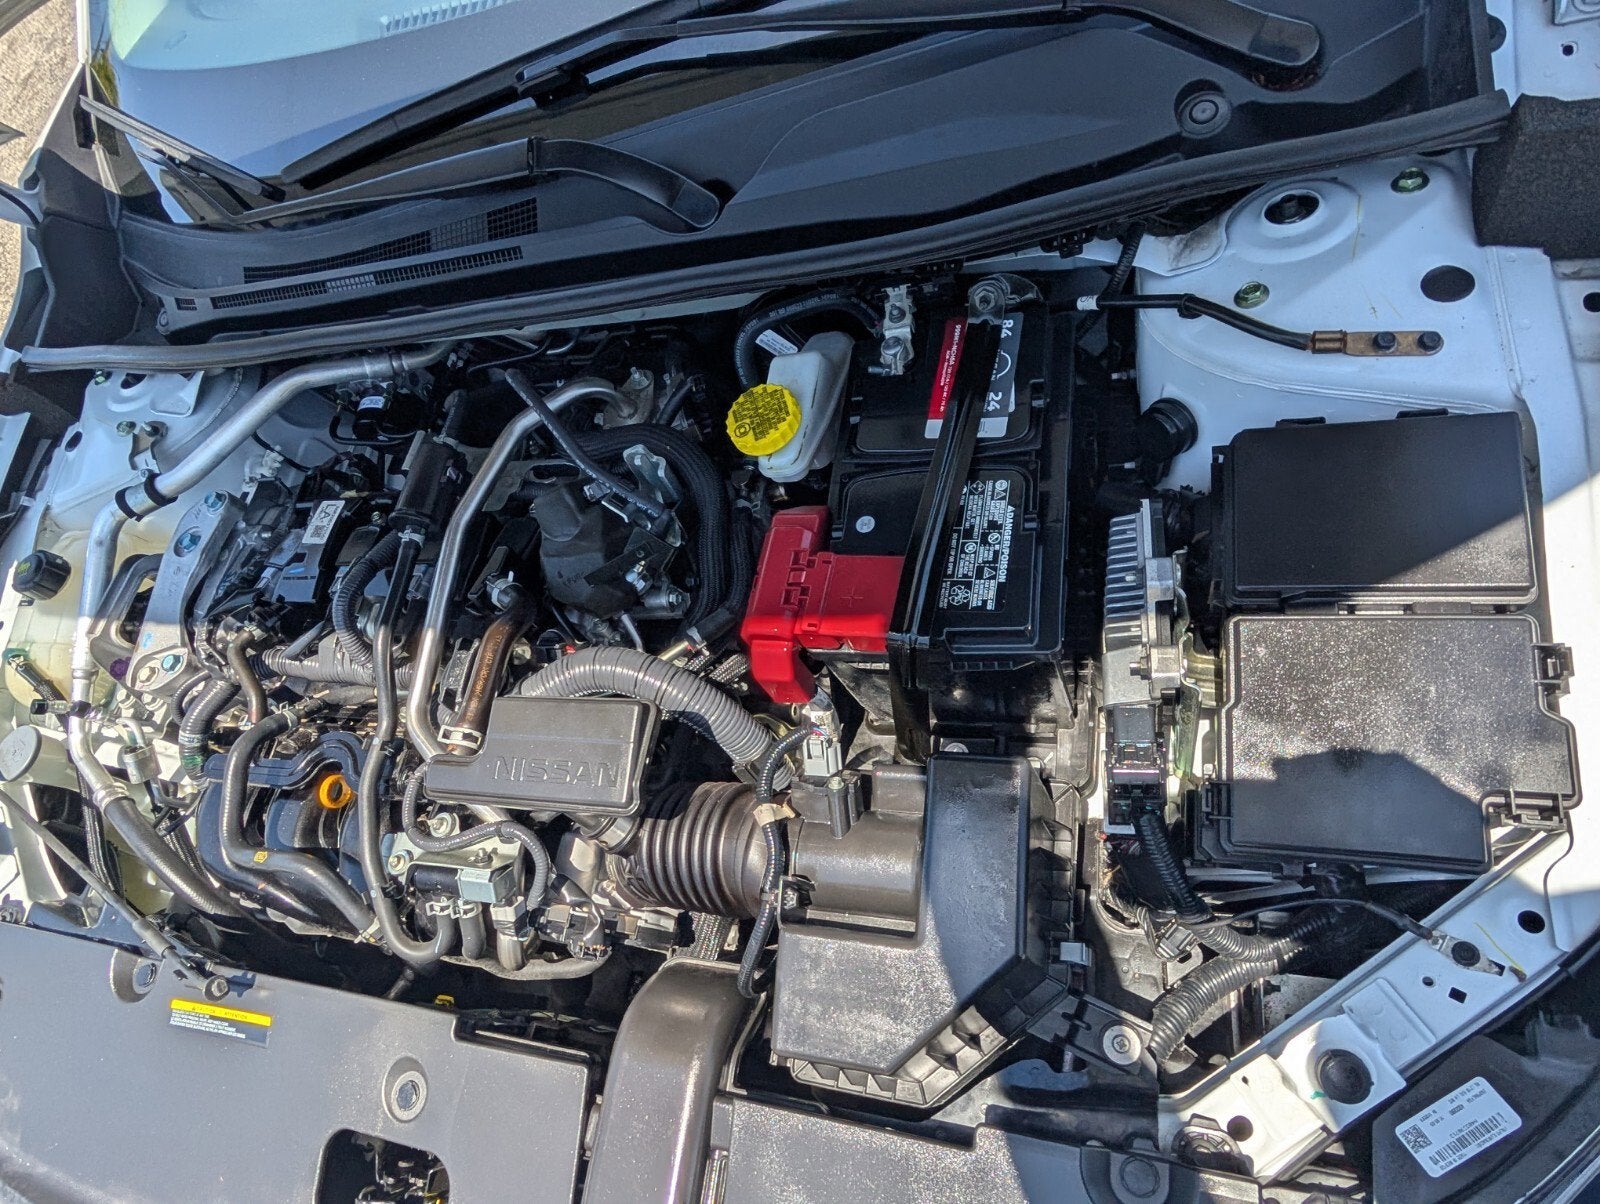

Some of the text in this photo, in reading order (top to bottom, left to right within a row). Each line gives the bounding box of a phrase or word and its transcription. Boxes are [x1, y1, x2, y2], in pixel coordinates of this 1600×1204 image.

[1001, 319, 1013, 338] 84
[988, 391, 1002, 412] 24
[998, 512, 1014, 582] DANGER/POISON
[491, 755, 620, 788] NISSAN
